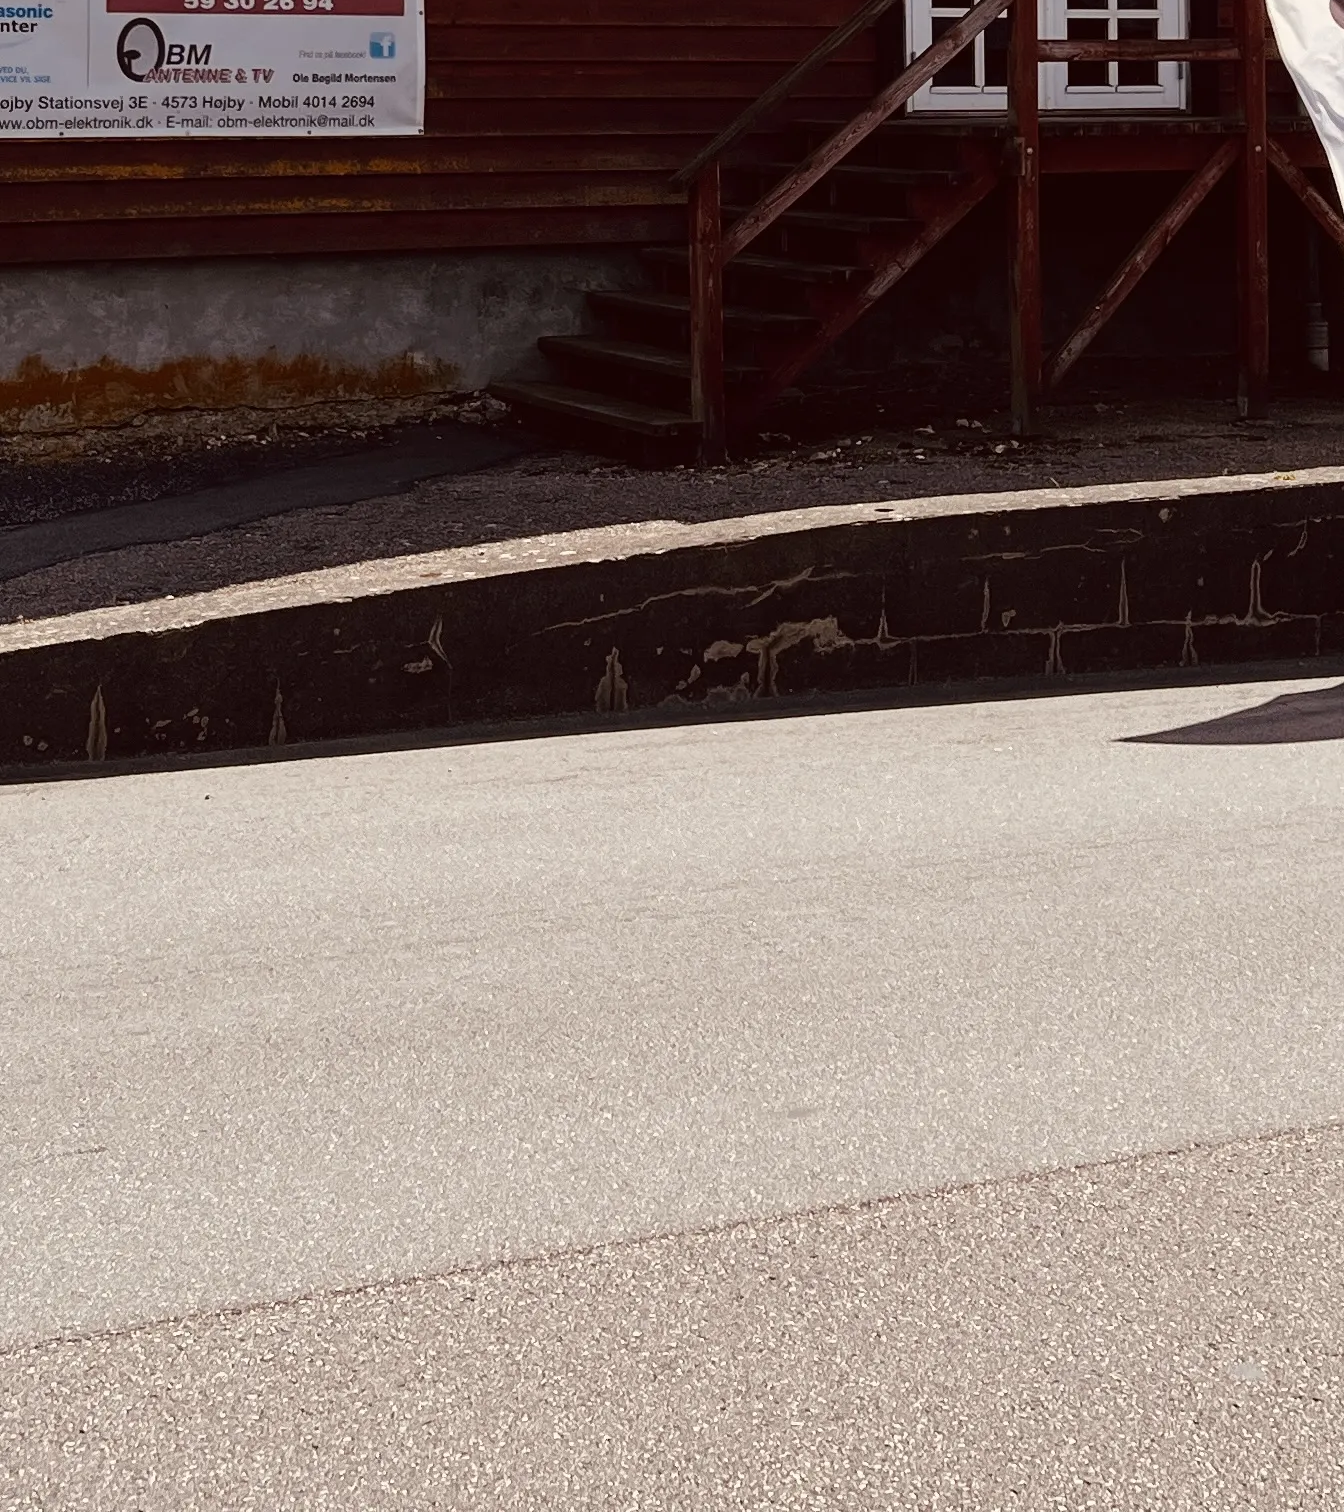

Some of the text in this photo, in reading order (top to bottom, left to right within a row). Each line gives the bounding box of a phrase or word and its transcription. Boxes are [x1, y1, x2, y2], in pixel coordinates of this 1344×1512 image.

[20, 75, 32, 84] VIL
[33, 75, 52, 84] SIGE
[144, 68, 274, 84] ANTENNE & TV
[293, 73, 309, 83] Ole
[345, 73, 397, 84] Mortensen
[38, 94, 125, 113] Stationsvej
[128, 95, 148, 110] 3E
[161, 95, 198, 110] 4573
[202, 94, 246, 113] Højby
[258, 94, 298, 110] Mobil
[302, 95, 337, 110] 4014
[341, 95, 375, 110] 2694
[165, 114, 213, 129] E-mail:
[217, 113, 376, 130] obm-elektronik@mail.dk
